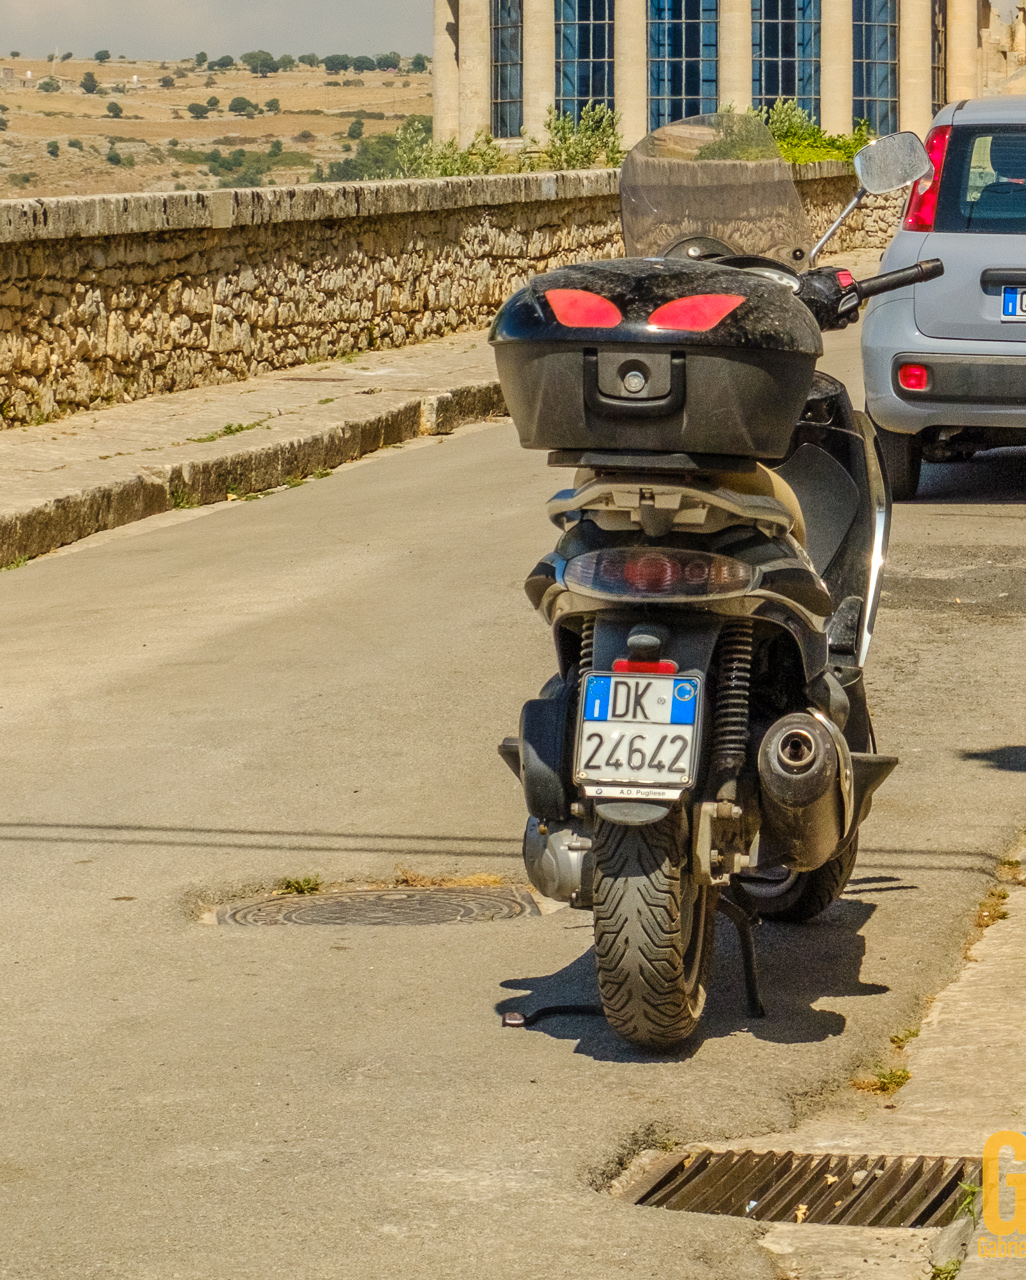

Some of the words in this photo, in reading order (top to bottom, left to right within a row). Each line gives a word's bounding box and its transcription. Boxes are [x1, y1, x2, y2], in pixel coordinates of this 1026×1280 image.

[611, 680, 653, 720] DK
[584, 732, 689, 774] 24642
[636, 789, 666, 797] Pugliese
